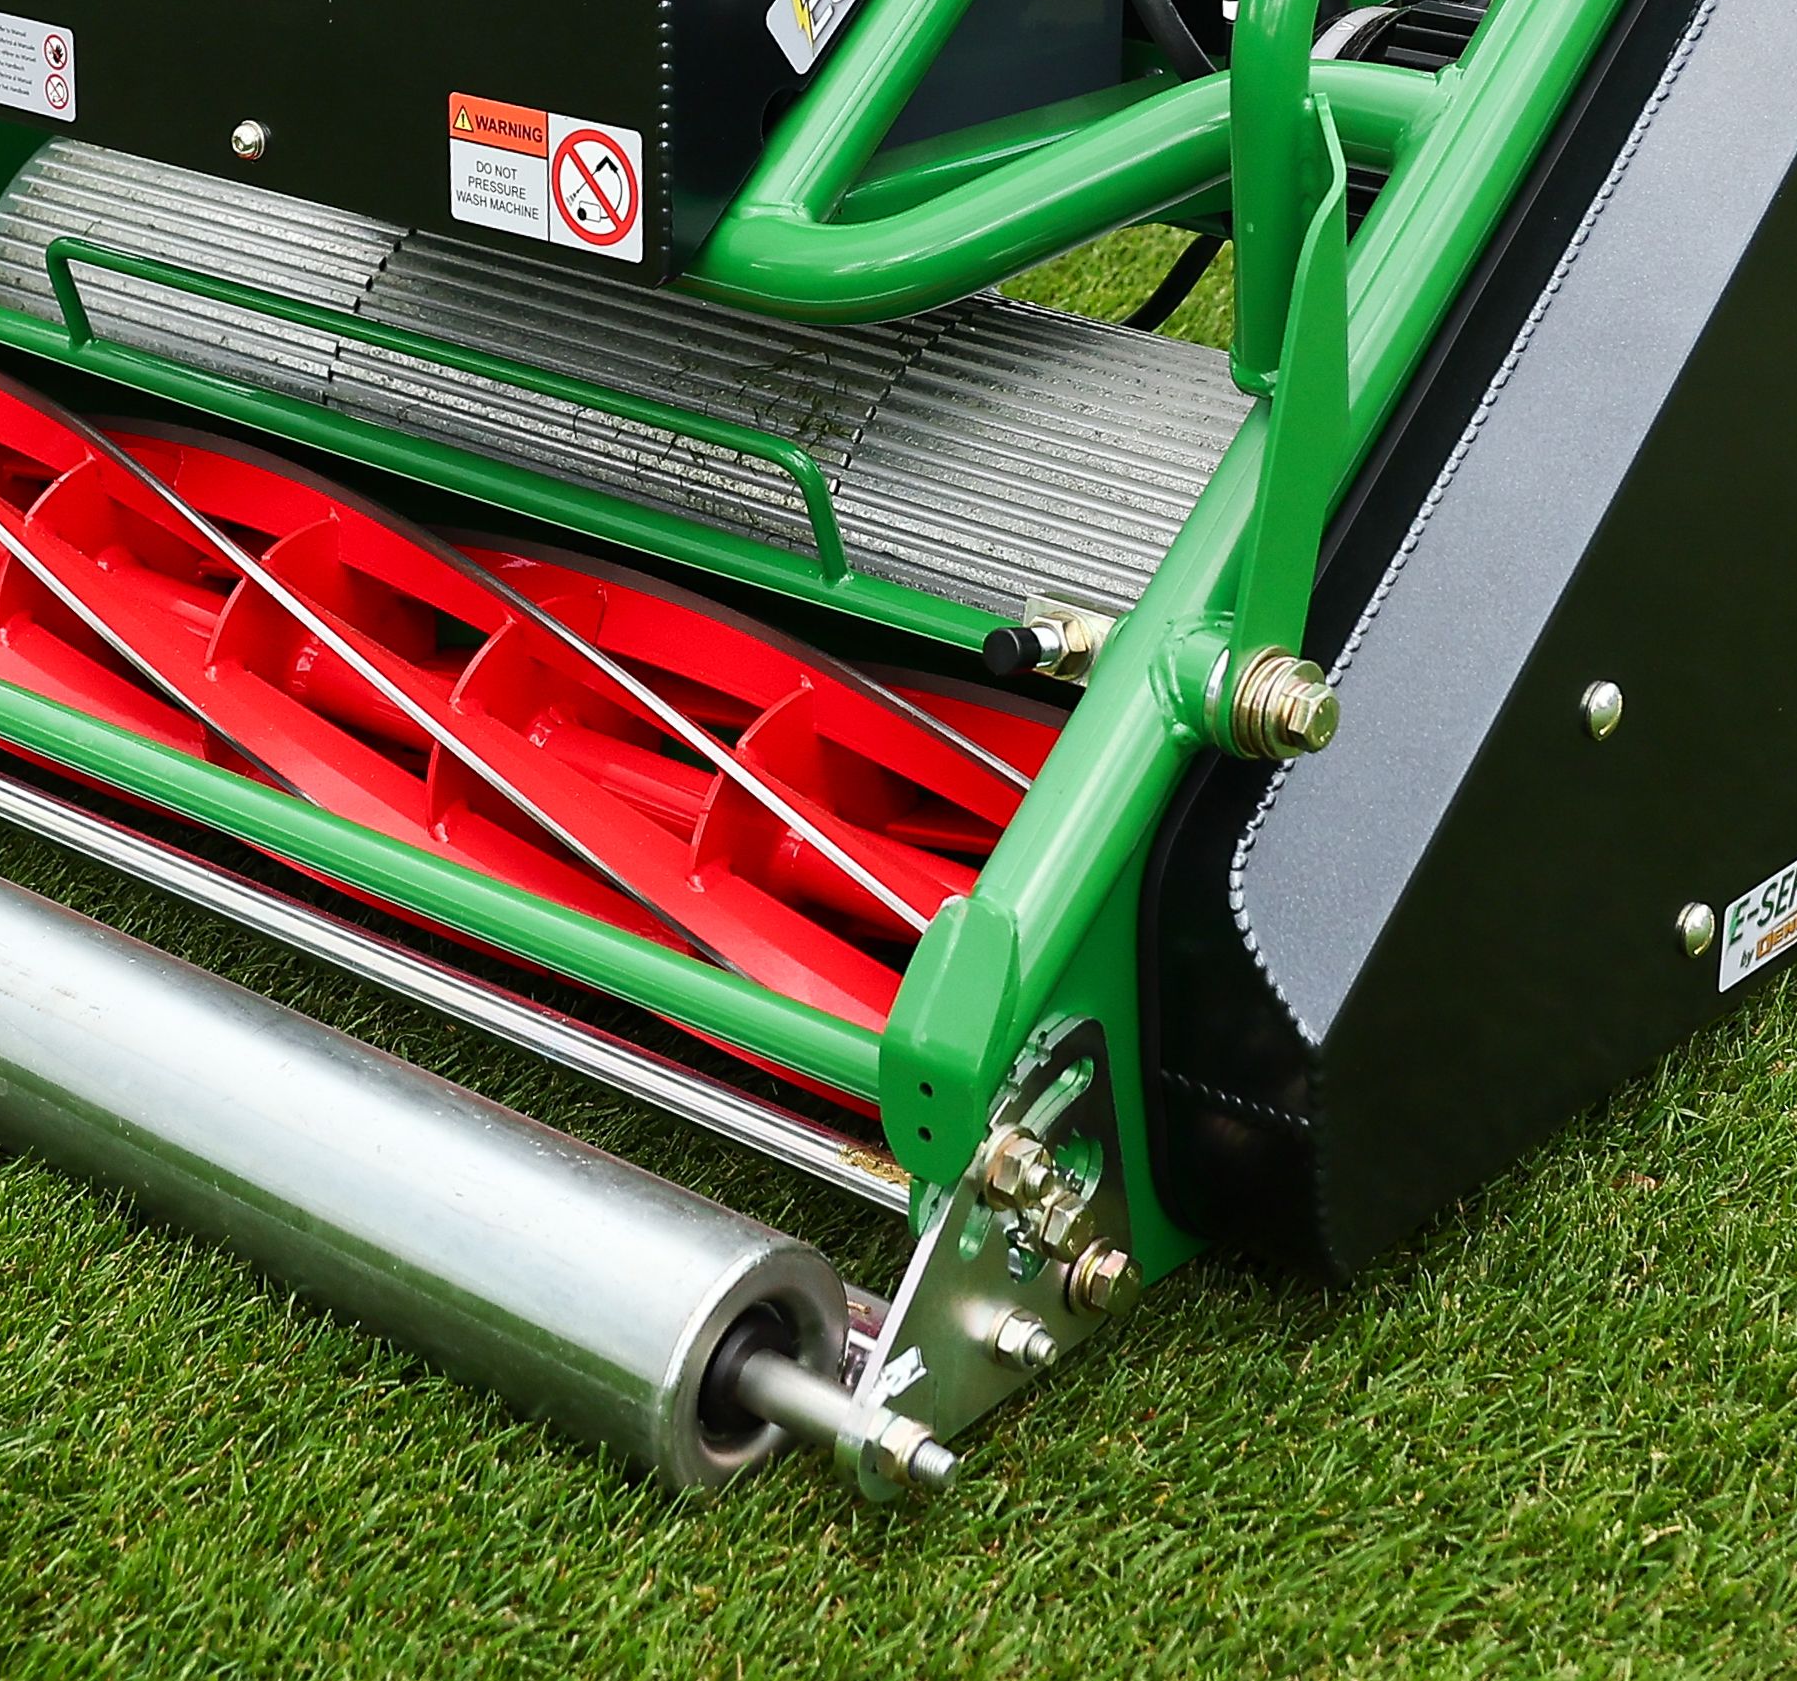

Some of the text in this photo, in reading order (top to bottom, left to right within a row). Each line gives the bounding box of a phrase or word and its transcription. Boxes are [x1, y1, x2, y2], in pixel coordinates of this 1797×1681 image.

[475, 114, 543, 144] WARNING
[476, 160, 518, 180] DO NOT
[467, 177, 527, 201] PRESSURE
[456, 189, 540, 220] WASH MACHINE
[1739, 946, 1755, 969] by
